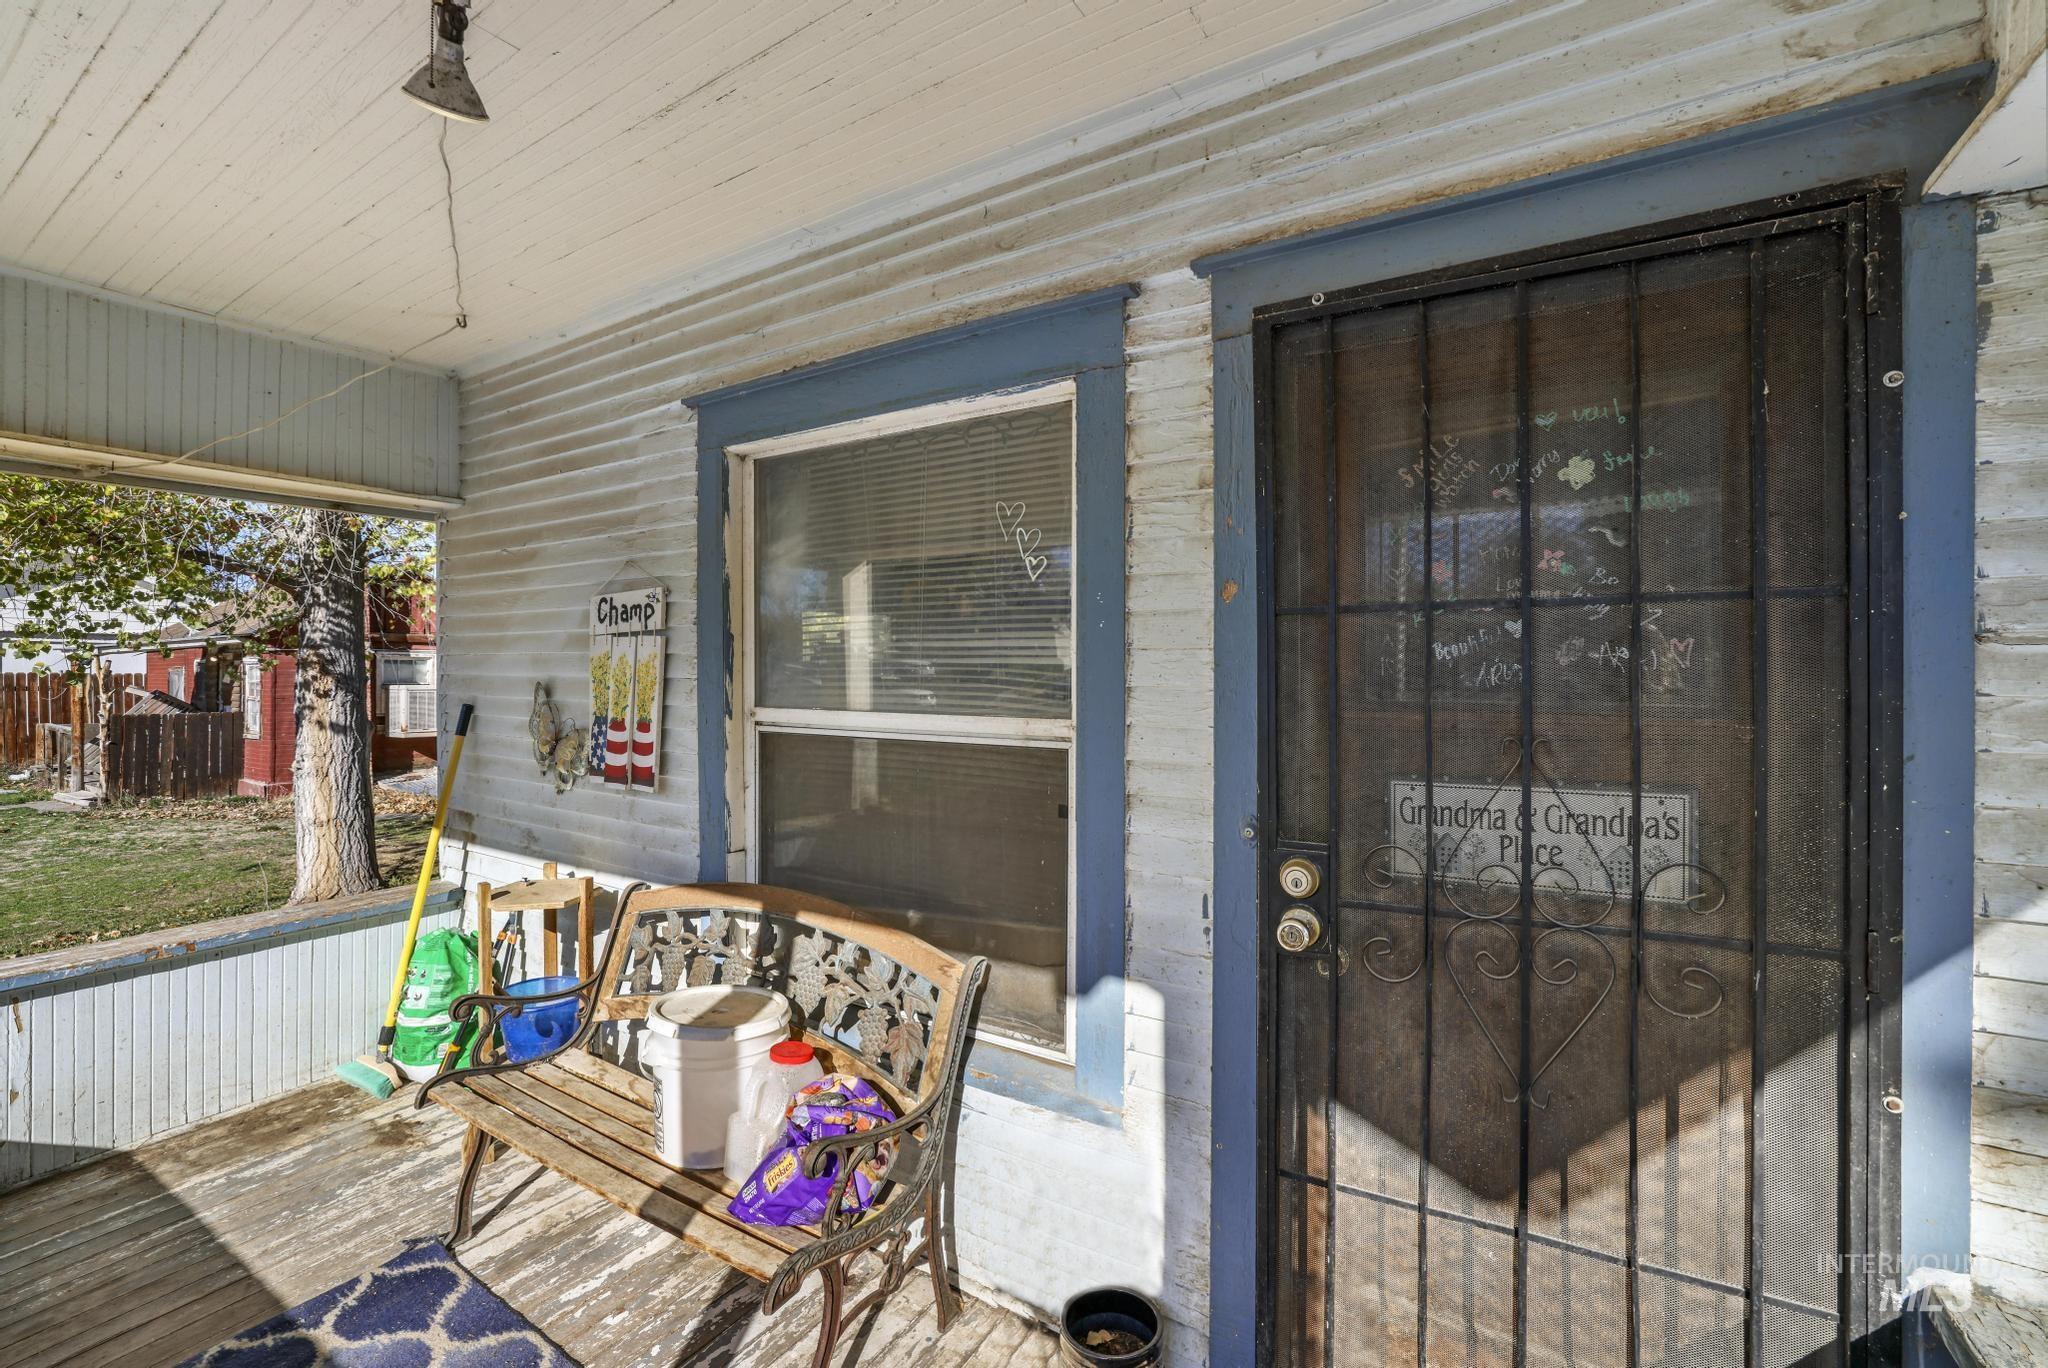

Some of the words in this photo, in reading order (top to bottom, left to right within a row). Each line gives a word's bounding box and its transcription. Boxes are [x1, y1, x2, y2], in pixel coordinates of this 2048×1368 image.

[597, 597, 655, 629] Champ
[1400, 796, 1506, 831] Grandma
[1500, 834, 1563, 867] Plce
